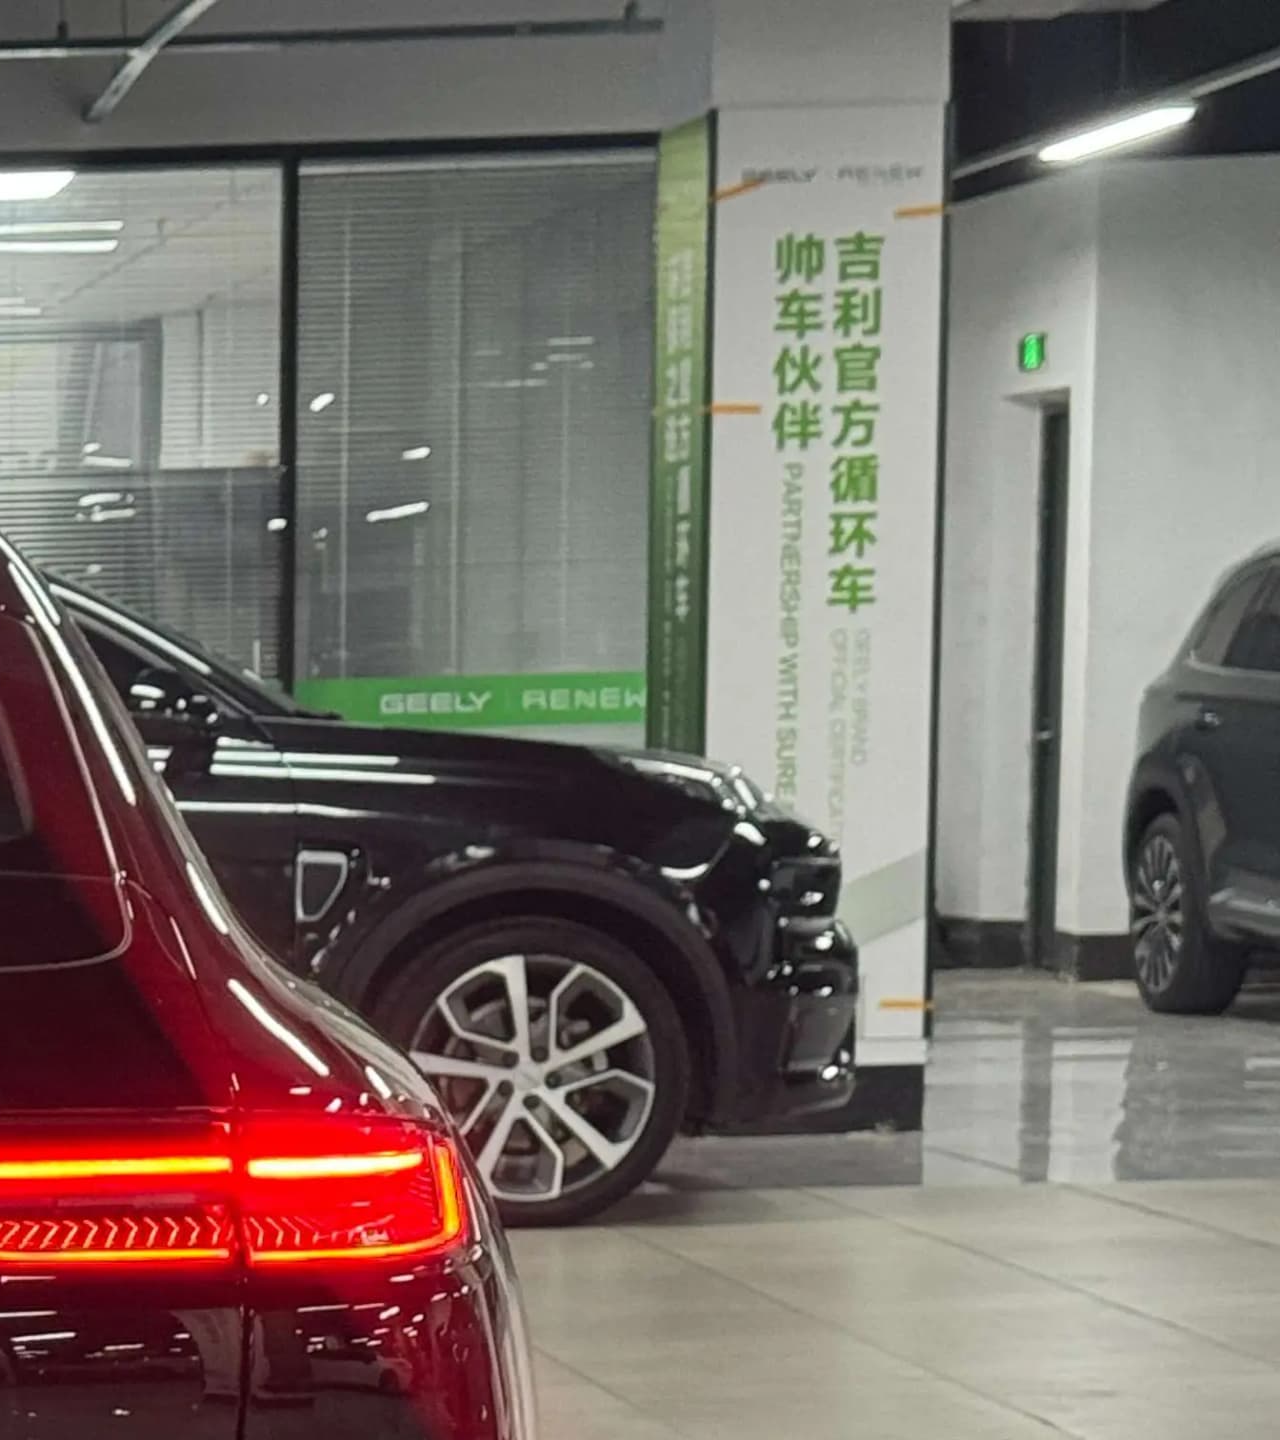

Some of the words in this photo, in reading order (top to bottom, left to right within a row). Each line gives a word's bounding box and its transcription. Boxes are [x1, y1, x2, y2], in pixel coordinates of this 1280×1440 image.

[772, 233, 825, 450] 帅车伙伴
[827, 231, 885, 615] 吉利官方循环车
[780, 461, 803, 649] PARTNERSHIP
[379, 691, 492, 715] GEELY
[777, 653, 799, 721] WITH
